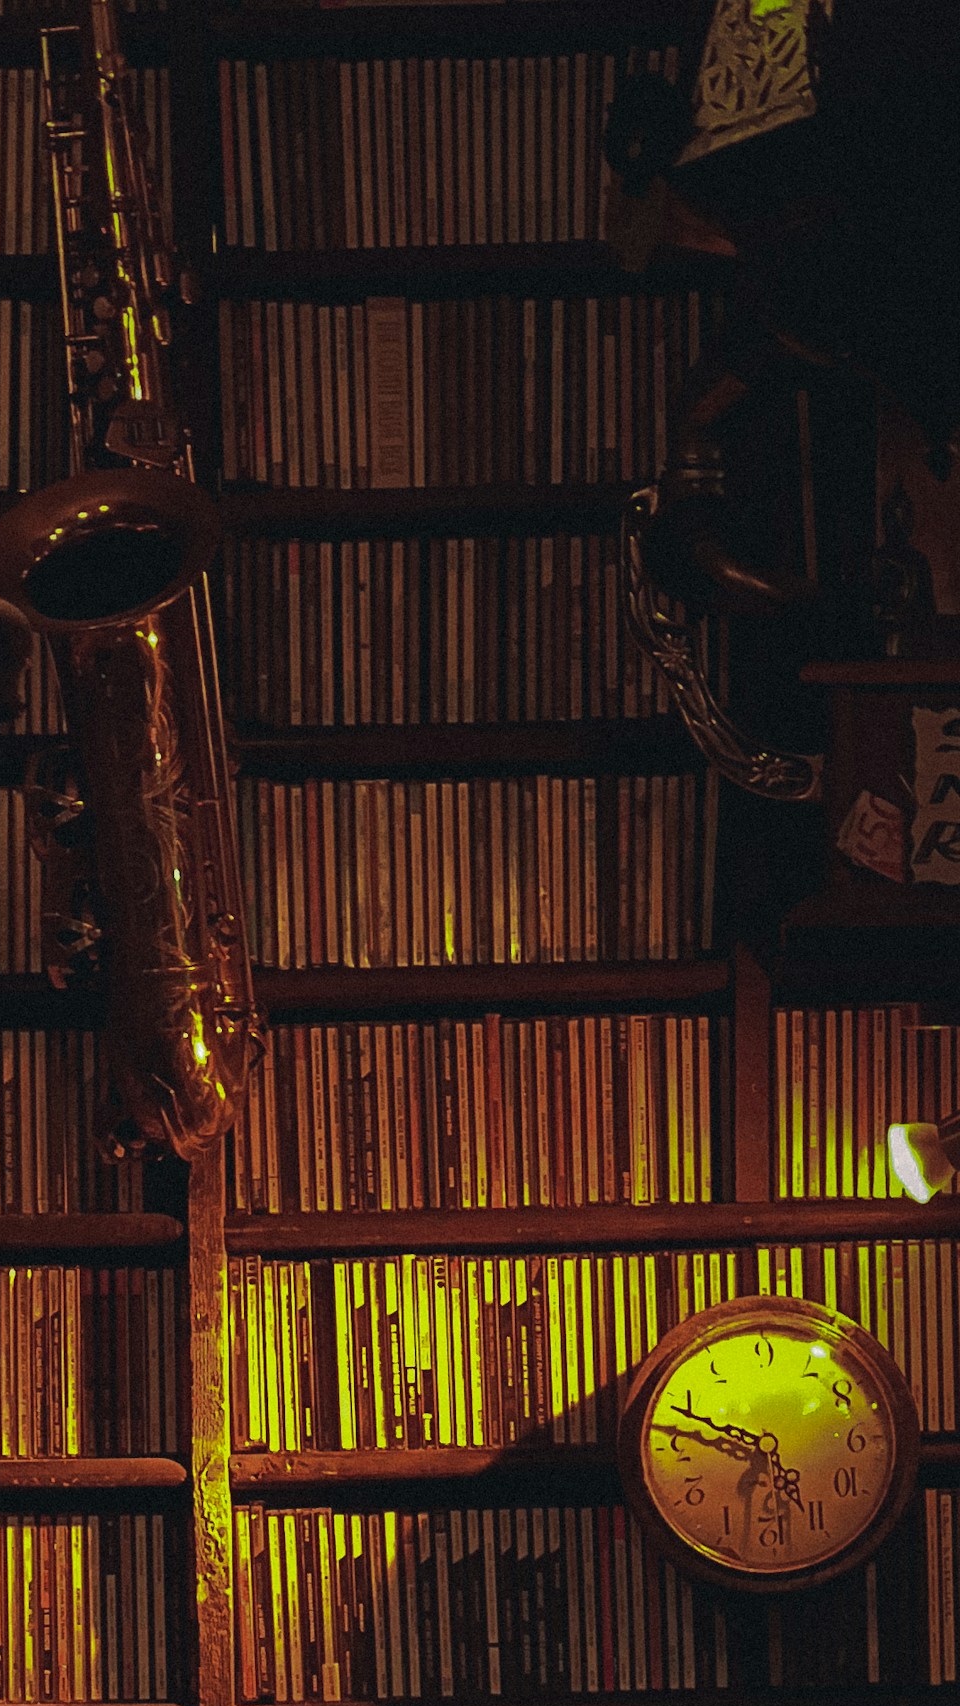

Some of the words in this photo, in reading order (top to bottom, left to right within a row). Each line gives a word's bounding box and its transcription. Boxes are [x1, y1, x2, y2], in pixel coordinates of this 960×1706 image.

[832, 1379, 852, 1411] 8
[684, 1475, 705, 1506] 2
[834, 1466, 858, 1498] 10
[723, 1505, 731, 1536] 1
[758, 1515, 785, 1547] 12
[808, 1500, 824, 1531] 11
